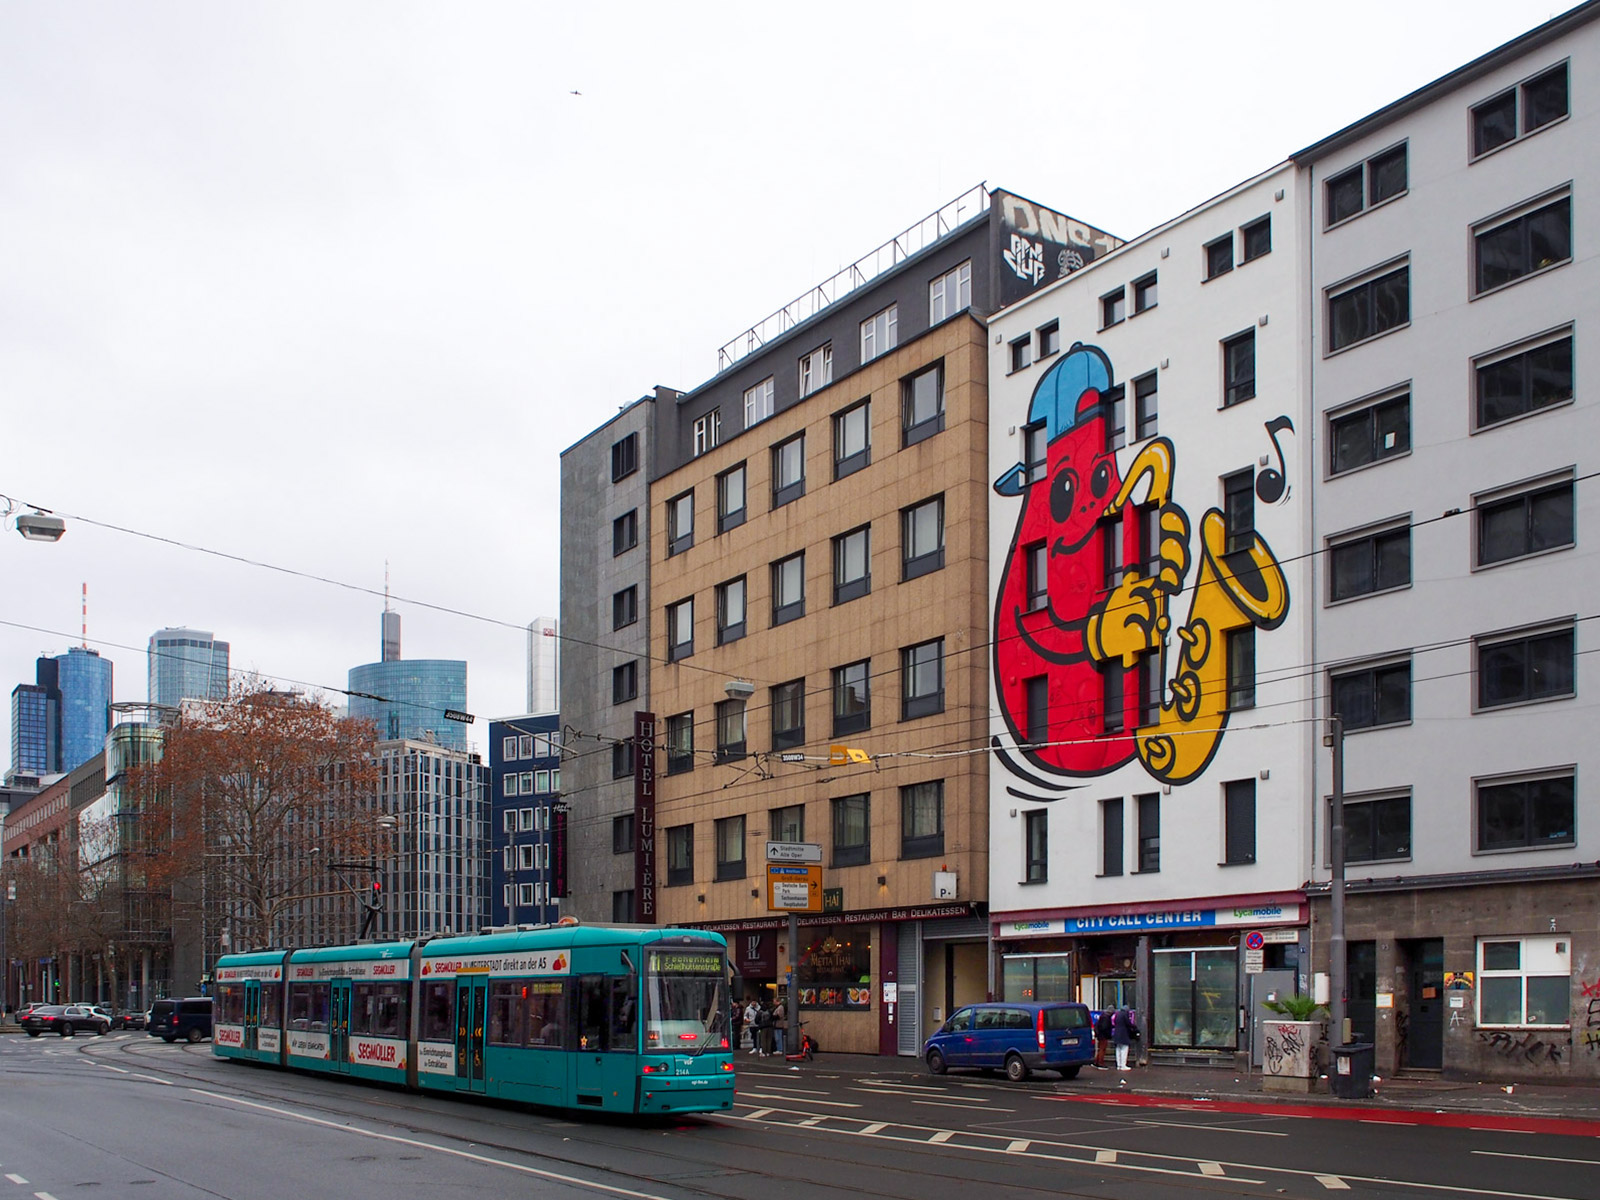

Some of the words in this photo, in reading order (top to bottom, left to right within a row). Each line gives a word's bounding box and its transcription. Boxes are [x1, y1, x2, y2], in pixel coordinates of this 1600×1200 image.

[640, 721, 653, 796] HOTEL
[641, 807, 653, 915] LUMIÈRE
[781, 919, 790, 927] BA
[844, 912, 888, 922] RESTAURANT
[911, 907, 966, 917] DELIKATESSEN
[1076, 917, 1104, 928] CITY
[1108, 914, 1141, 926] CALL
[1145, 911, 1201, 924] CENTER
[1233, 907, 1282, 919] Lycamobile
[1014, 920, 1050, 931] Lycamobile
[435, 962, 462, 973] SEGMÜLLER
[503, 958, 518, 971] direkt
[519, 961, 526, 970] an
[528, 958, 537, 969] der
[538, 957, 546, 970] A5
[358, 1042, 396, 1062] SEGMÜLLER
